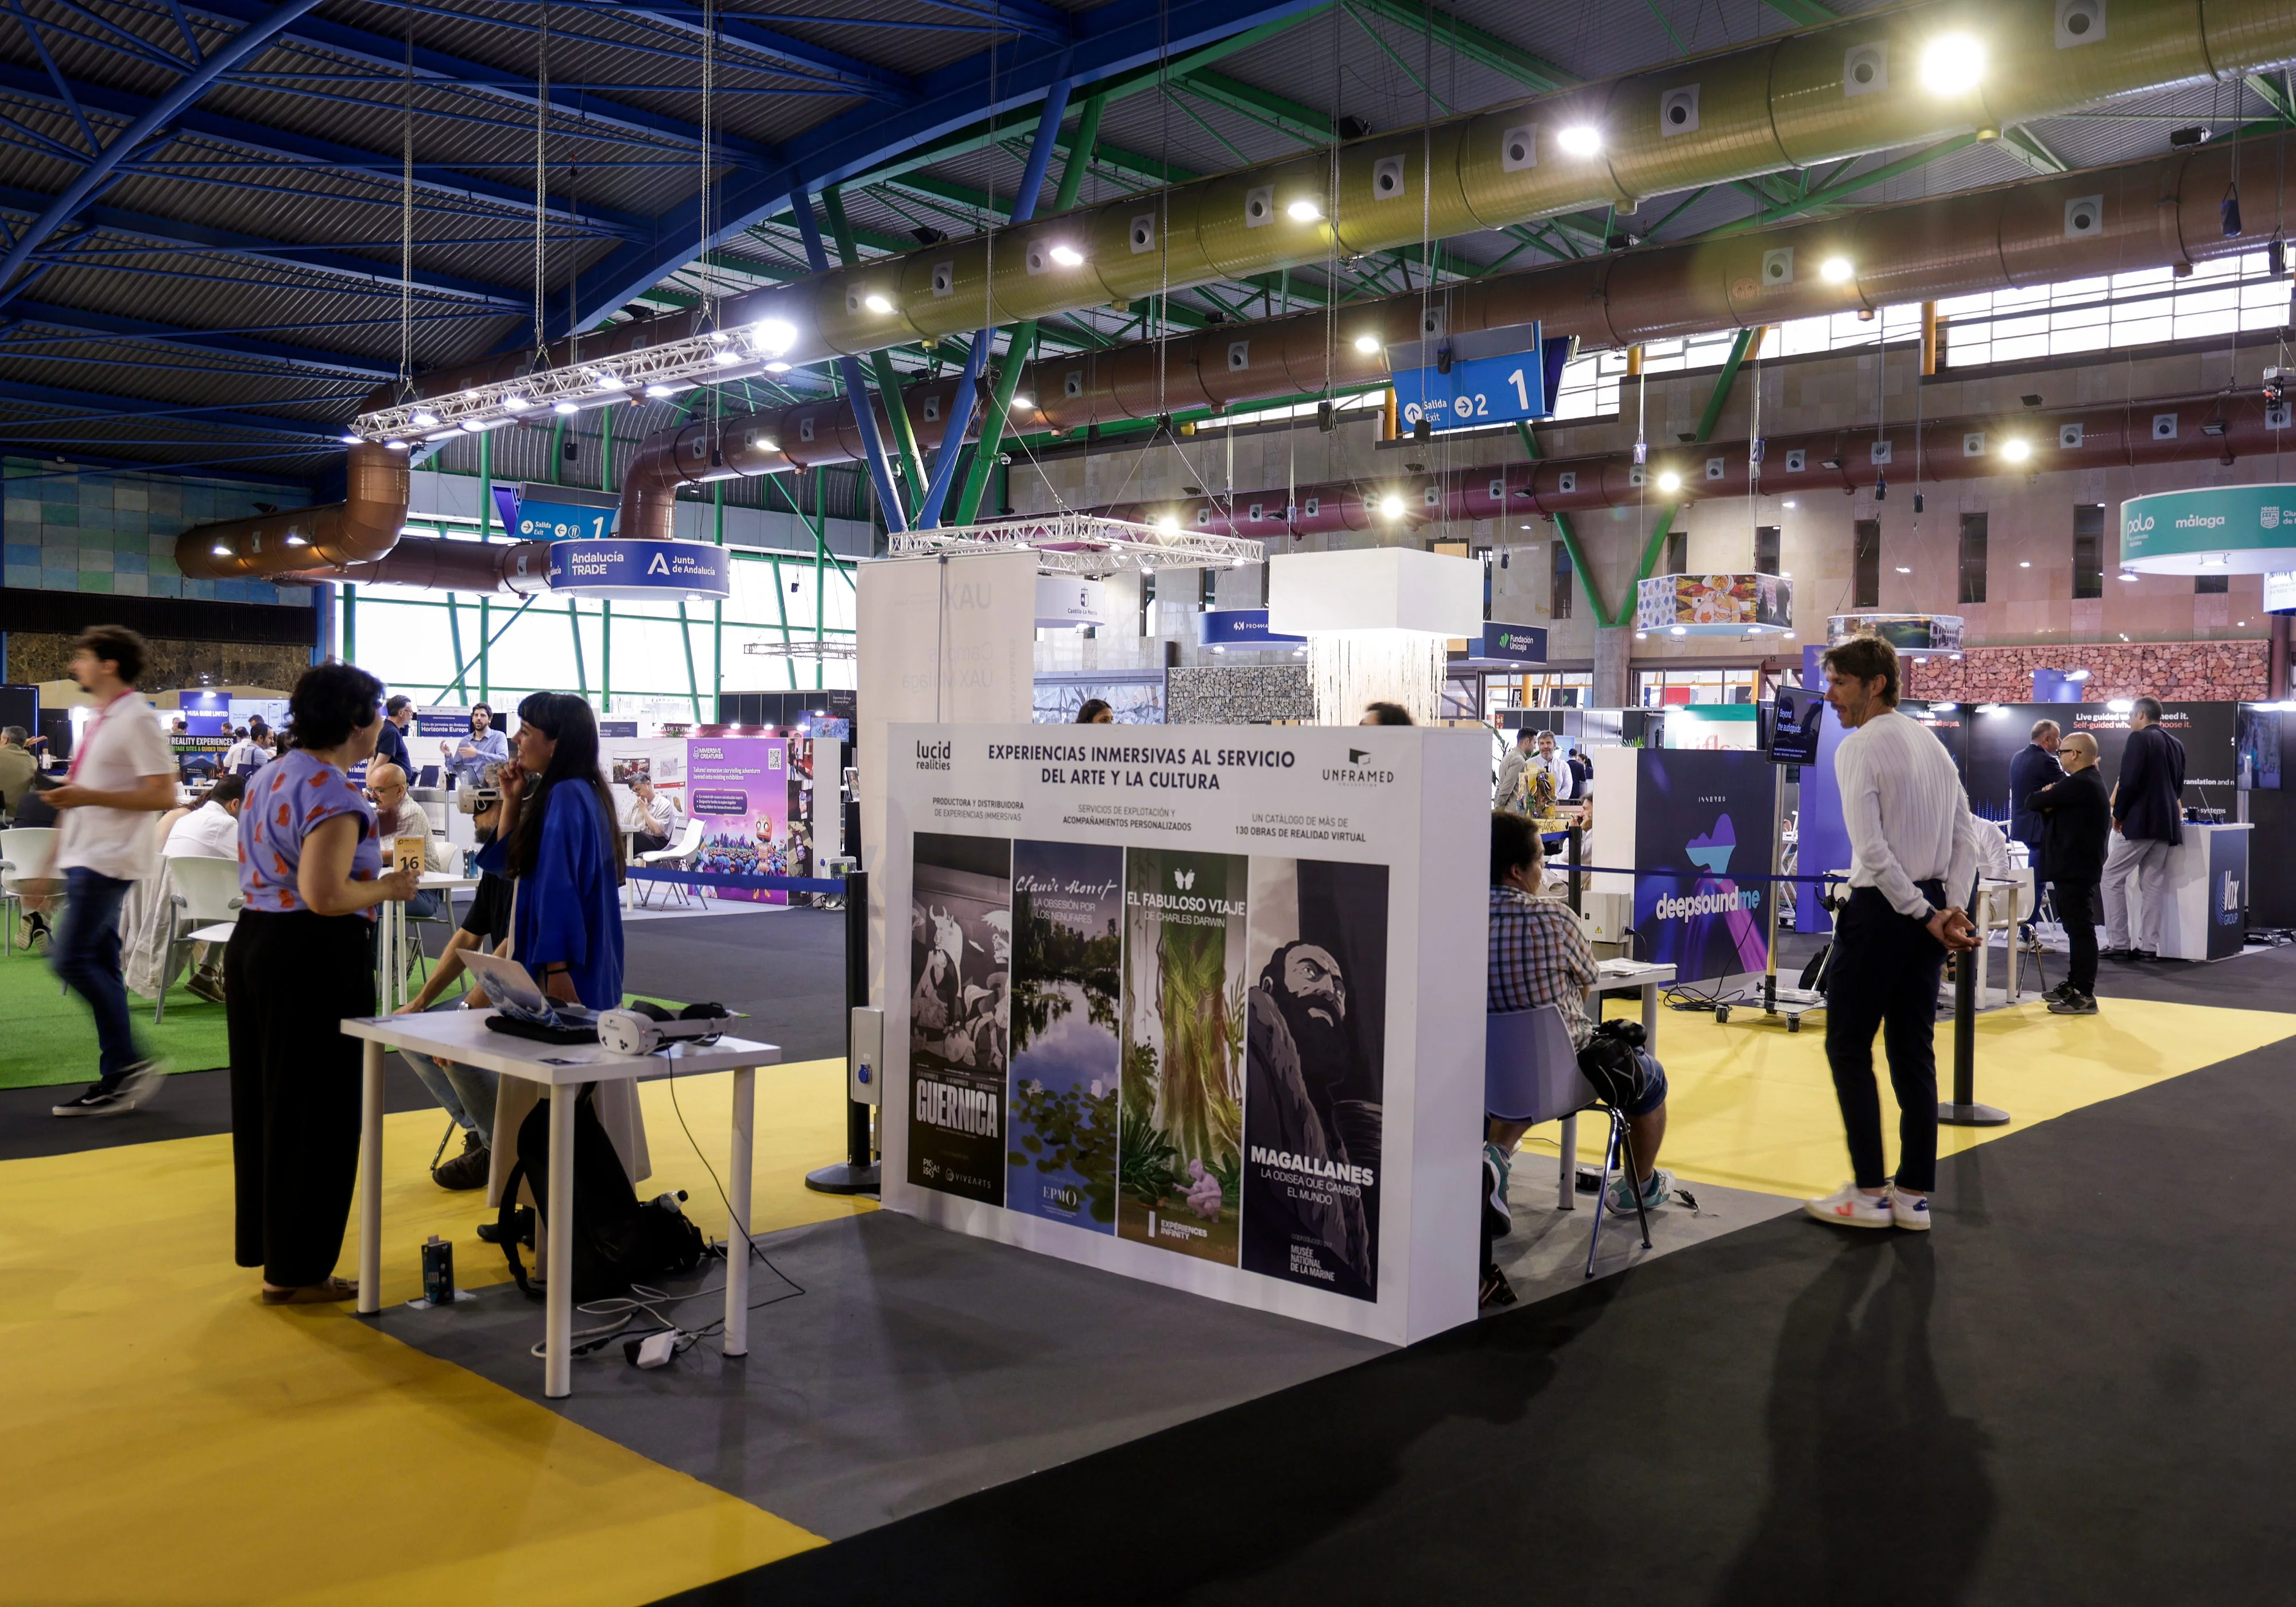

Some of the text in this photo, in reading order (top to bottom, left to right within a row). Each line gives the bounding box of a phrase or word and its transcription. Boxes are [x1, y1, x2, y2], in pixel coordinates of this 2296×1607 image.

[1508, 368, 1529, 410] 1
[1423, 394, 1488, 416] Salida 2
[1426, 413, 1440, 422] Exit
[593, 517, 603, 539] 1
[572, 551, 625, 564] Andalucía
[672, 556, 695, 565] Junta
[572, 564, 607, 576] TRADE
[672, 565, 715, 576] de Andalucía
[1510, 634, 1534, 644] Fundación
[1510, 643, 1527, 653] Unicaja
[1779, 709, 1792, 719] Beyond
[2093, 713, 2119, 721] guided
[1783, 724, 1801, 734] audioguide.
[172, 737, 195, 745] REALITY
[196, 737, 234, 746] EXPERIENCES
[917, 740, 951, 759] lucid
[988, 745, 1295, 768] EXPERIENCIAS INMERSIVAS AL SERVICIO
[917, 760, 951, 770] realities
[1041, 768, 1220, 790] DEL ARTE Y LA CULTURA
[1322, 769, 1394, 783] UNFRAMED
[932, 797, 971, 806] PRODUCTORA
[978, 799, 1024, 809] DISTRIBUIDORA
[934, 809, 1021, 821] DE EXPERIENCIAS IMMERSIVAS
[1078, 804, 1176, 817] SERVICIOS DE EXPLOTACIÓN Y
[1062, 816, 1192, 831] ACOMPAÑAMIENTOS PERSONALIZADOS
[1252, 814, 1263, 822] UN
[1306, 816, 1316, 826] DE
[1338, 818, 1348, 828] DE
[1235, 826, 1366, 843] 130 OBRAS DE REALIDAD VIRTUAL
[400, 856, 419, 870] 16
[1015, 875, 1118, 900] Claude Monet
[1034, 898, 1096, 912] LA OBSESIÓN POR
[1127, 891, 1246, 916] EL FABULOSO VIAJE
[1656, 886, 1760, 923] deepsoundme
[1037, 910, 1092, 924] LOS NENÚFARES
[1145, 911, 1225, 927] DE CHARLES DARWIN
[2224, 913, 2238, 926] GROUP
[916, 1079, 998, 1139] GUERNICA
[1251, 1146, 1374, 1186] MAGALLANES
[956, 1173, 991, 1189] VIVEARTS
[1261, 1168, 1362, 1198] LA ODISEA QUE CAMBIÓ
[1043, 1186, 1077, 1206] EPMO
[1287, 1187, 1332, 1205] EL MUNDO
[1161, 1220, 1207, 1237] EXPERIENCES
[1161, 1227, 1190, 1240] INFINITY
[1291, 1244, 1314, 1258] MUSÉE
[1291, 1255, 1321, 1270] NATIONAL
[1290, 1262, 1335, 1282] DE LA MARINE
